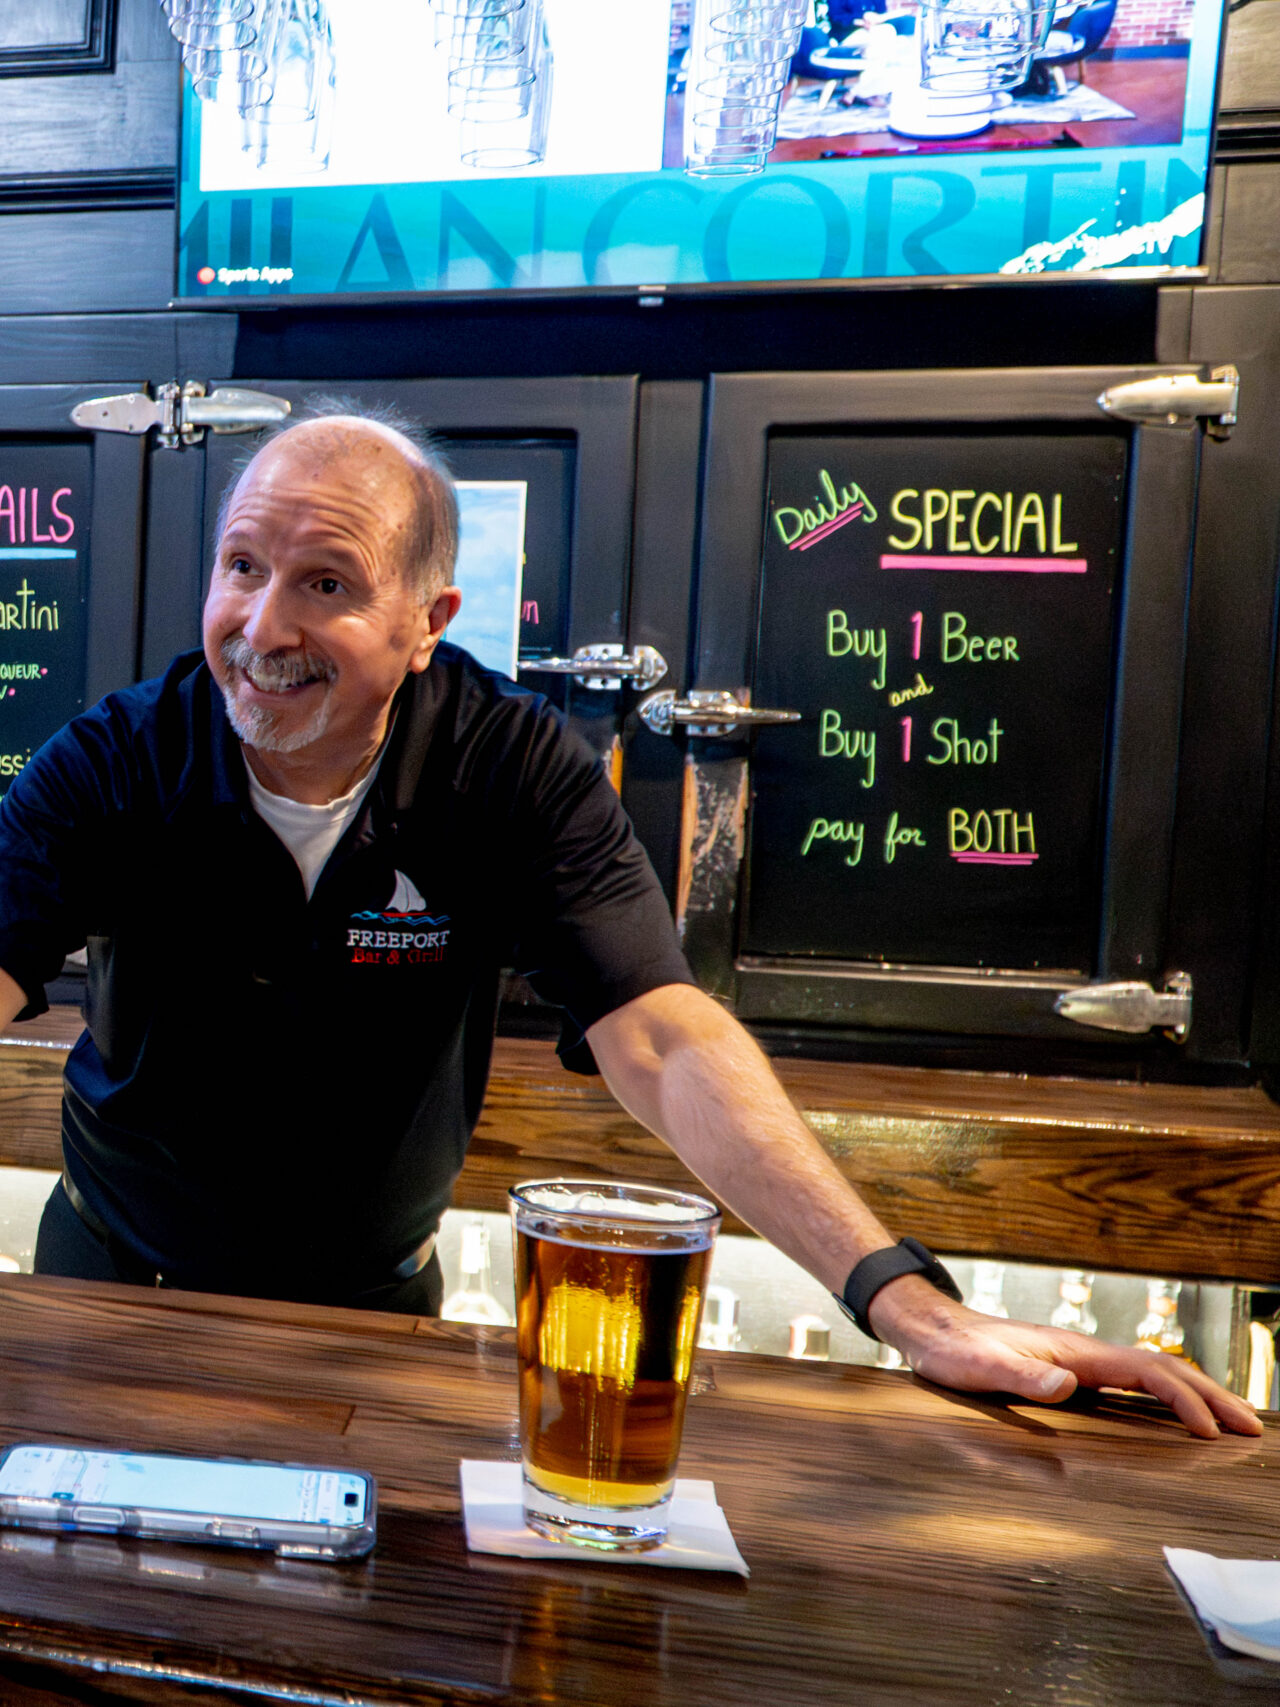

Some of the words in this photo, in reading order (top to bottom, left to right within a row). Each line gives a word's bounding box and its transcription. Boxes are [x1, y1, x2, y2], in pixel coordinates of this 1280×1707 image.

[775, 469, 878, 545] Daily
[888, 488, 1078, 554] SPECIAL
[827, 609, 887, 690] Buy
[910, 611, 923, 660] 1
[889, 673, 934, 706] and
[820, 709, 876, 788] Buy
[900, 716, 912, 762] 1
[926, 717, 1004, 765] Shot
[800, 817, 864, 866] pay
[884, 812, 926, 863] for
[948, 807, 1036, 854] BOTH
[346, 928, 451, 949] FREEPORT
[351, 946, 380, 964] Bar
[386, 949, 400, 965] &
